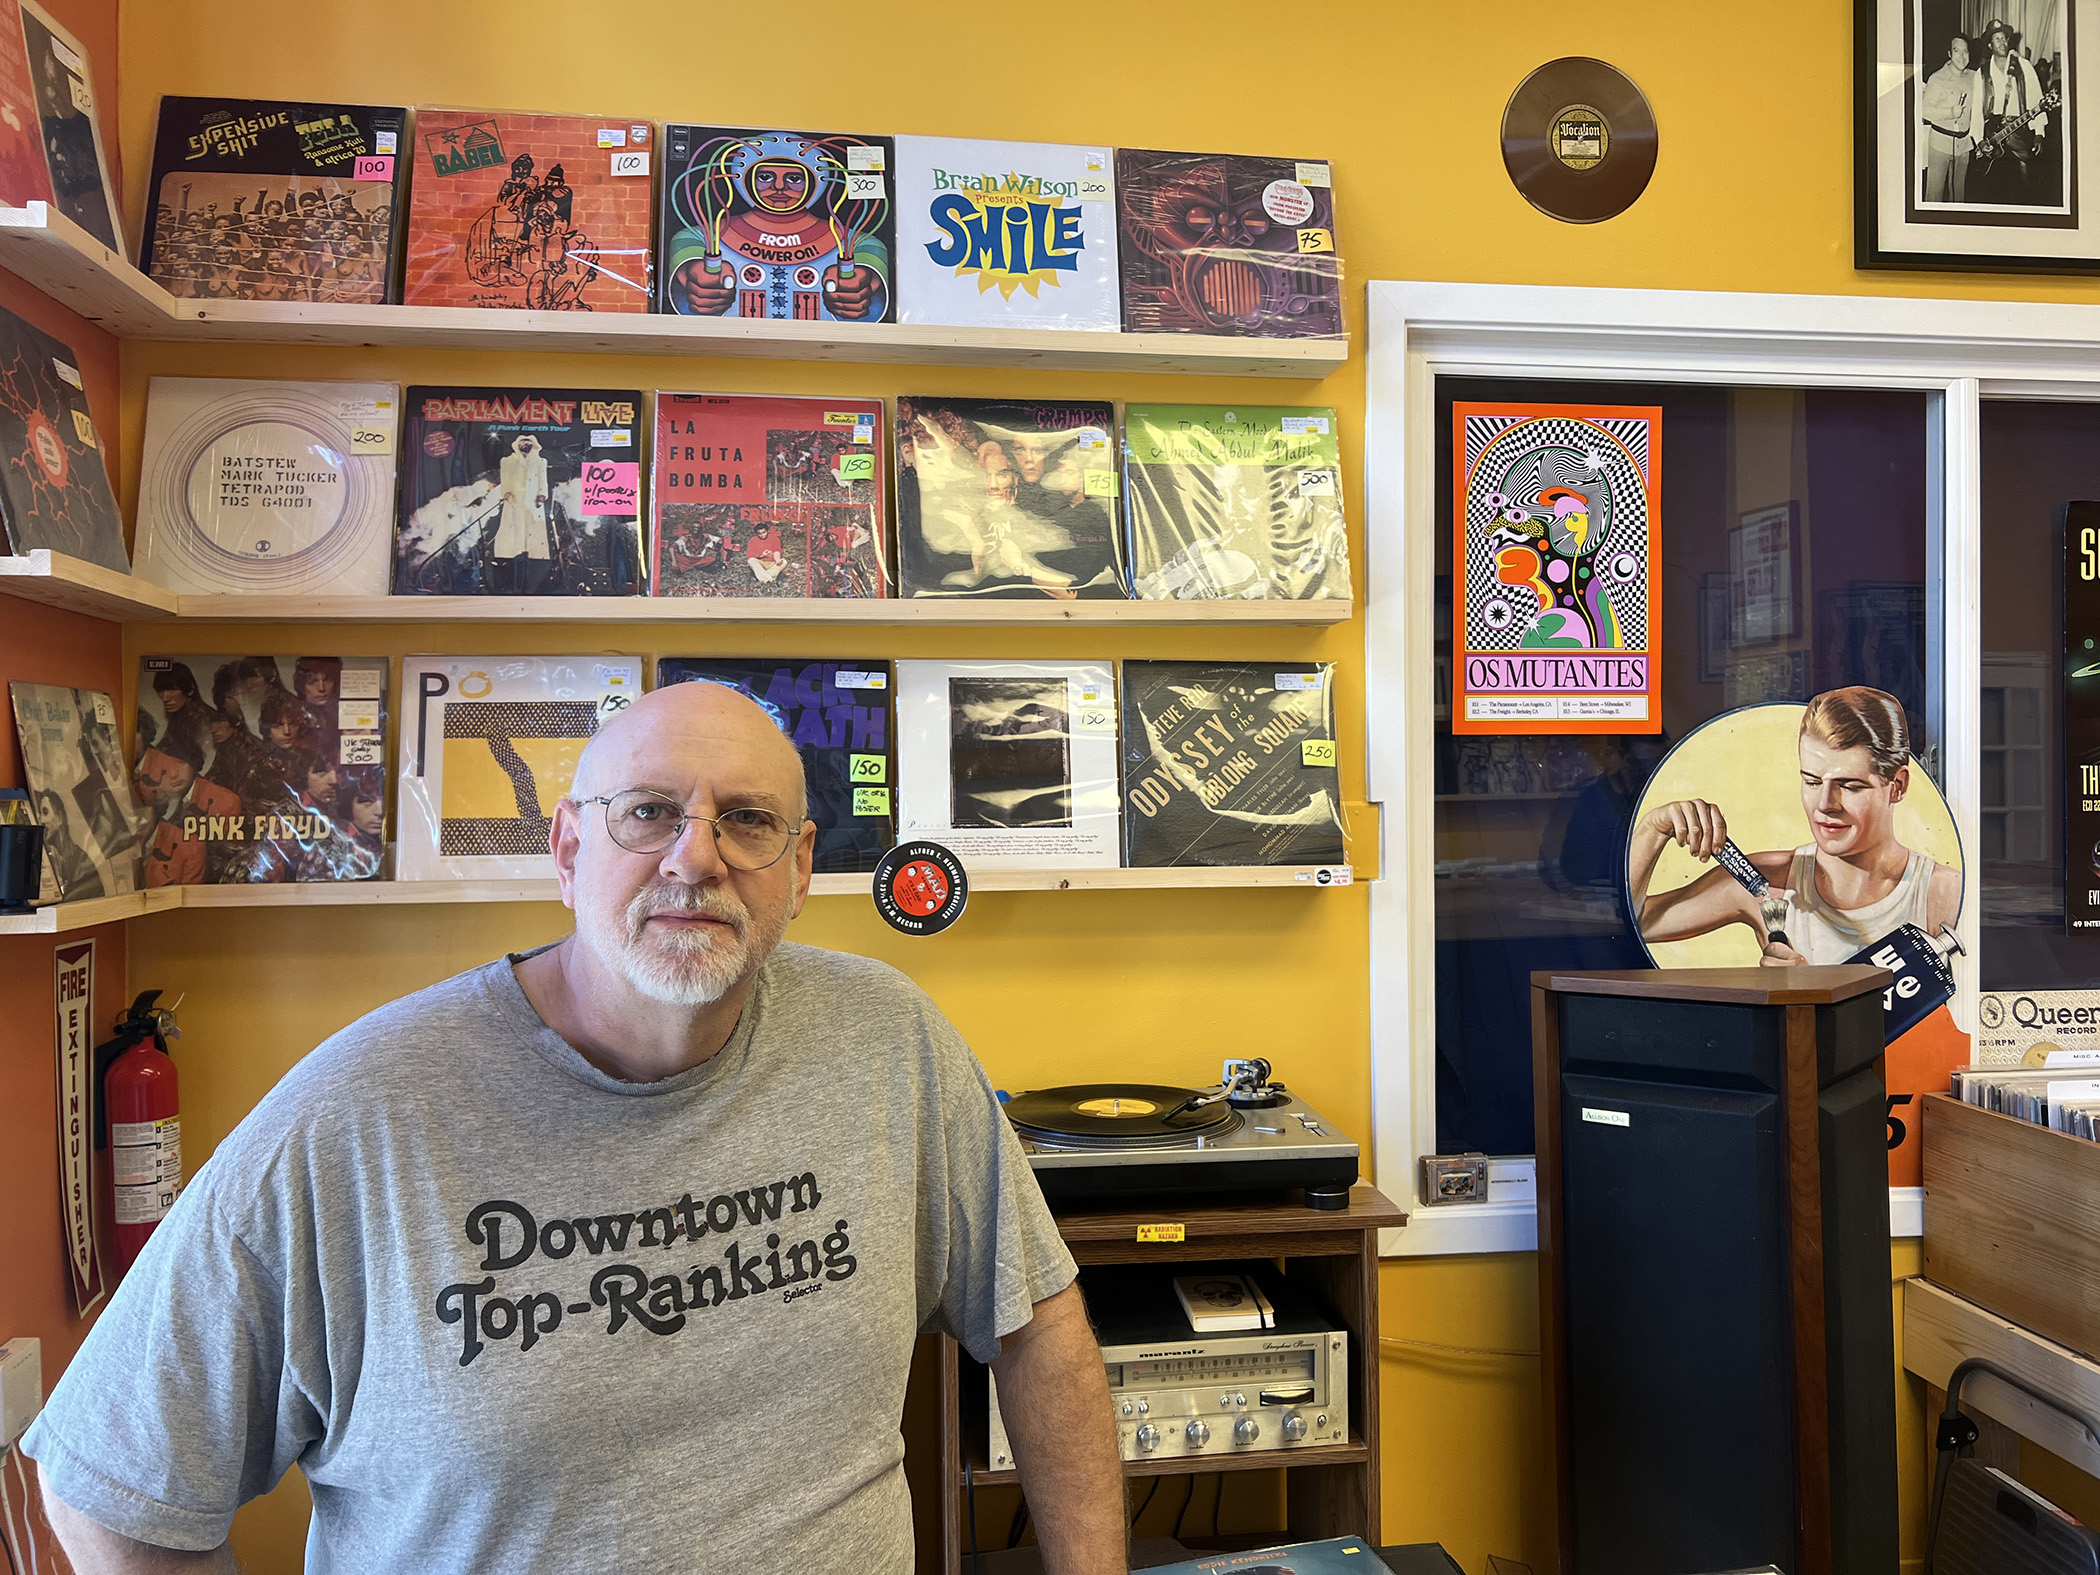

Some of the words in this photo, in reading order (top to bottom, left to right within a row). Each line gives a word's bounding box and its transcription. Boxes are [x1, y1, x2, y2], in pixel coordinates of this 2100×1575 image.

[74, 85, 92, 108] 120
[185, 112, 289, 160] EXPENSIVE
[1560, 123, 1600, 136] Vocalion
[217, 134, 258, 156] SHIT
[304, 143, 344, 160] Ransome
[315, 158, 324, 167] &
[353, 145, 367, 155] 70
[433, 144, 505, 176] BABEL
[617, 157, 641, 171] 100
[359, 161, 385, 175] 100
[851, 178, 876, 192] 300
[932, 168, 998, 191] Brian
[1001, 173, 1078, 198] Wilson
[1082, 182, 1106, 193] 200
[976, 194, 1025, 205] Presents
[759, 233, 801, 246] FROM
[1300, 232, 1322, 248] 75
[739, 243, 793, 262] POWER
[422, 394, 577, 426] PARLIAMENT
[581, 401, 635, 428] LIVE
[1034, 407, 1108, 431] CRAMPS
[671, 420, 695, 434] LA
[353, 431, 385, 444] 200
[670, 446, 743, 462] FRUTA
[222, 457, 297, 469] BATSTEW
[844, 459, 872, 473] 150
[221, 470, 263, 481] MARK
[276, 471, 337, 483] TUCKER
[586, 465, 616, 482] 100
[669, 473, 743, 488] BOMBA
[1089, 475, 1111, 489] 75
[1300, 473, 1328, 486] 500
[221, 483, 305, 495] TETRAPOD
[220, 496, 250, 507] TDS
[2081, 528, 2100, 580] S
[1469, 659, 1500, 688] OS
[1504, 659, 1645, 688] MUTANTES
[601, 695, 632, 711] 150
[1153, 703, 1185, 740] STEVE
[1179, 683, 1208, 711] REID
[1230, 703, 1242, 719] of
[1081, 712, 1106, 725] 150
[1236, 713, 1255, 731] the
[346, 754, 373, 764] 300
[1200, 749, 1258, 807] OBLONG
[1254, 699, 1314, 755] SQUARE
[1305, 746, 1332, 759] 250
[851, 759, 881, 776] 150
[1129, 713, 1235, 818] ODYSSEY
[2080, 765, 2100, 795] TH
[855, 805, 881, 813] POSTER
[253, 815, 331, 841] FLOYD
[910, 847, 935, 856] ALFRED
[943, 857, 961, 884] NEUMAN
[1724, 841, 1759, 878] CKMORE
[1729, 857, 1752, 882] Shave
[920, 864, 947, 900] MAD
[896, 916, 923, 929] RECORD
[59, 966, 87, 1003] FIRE
[67, 1008, 89, 1267] EXTINGUISHER
[465, 1171, 822, 1271] Downtown
[436, 1219, 858, 1367] Top-Ranking
[783, 1282, 823, 1304] Selector
[1139, 1349, 1206, 1358] marantz
[1197, 1560, 1228, 1570] EDDIE
[1230, 1551, 1288, 1565] KENDRICKS
